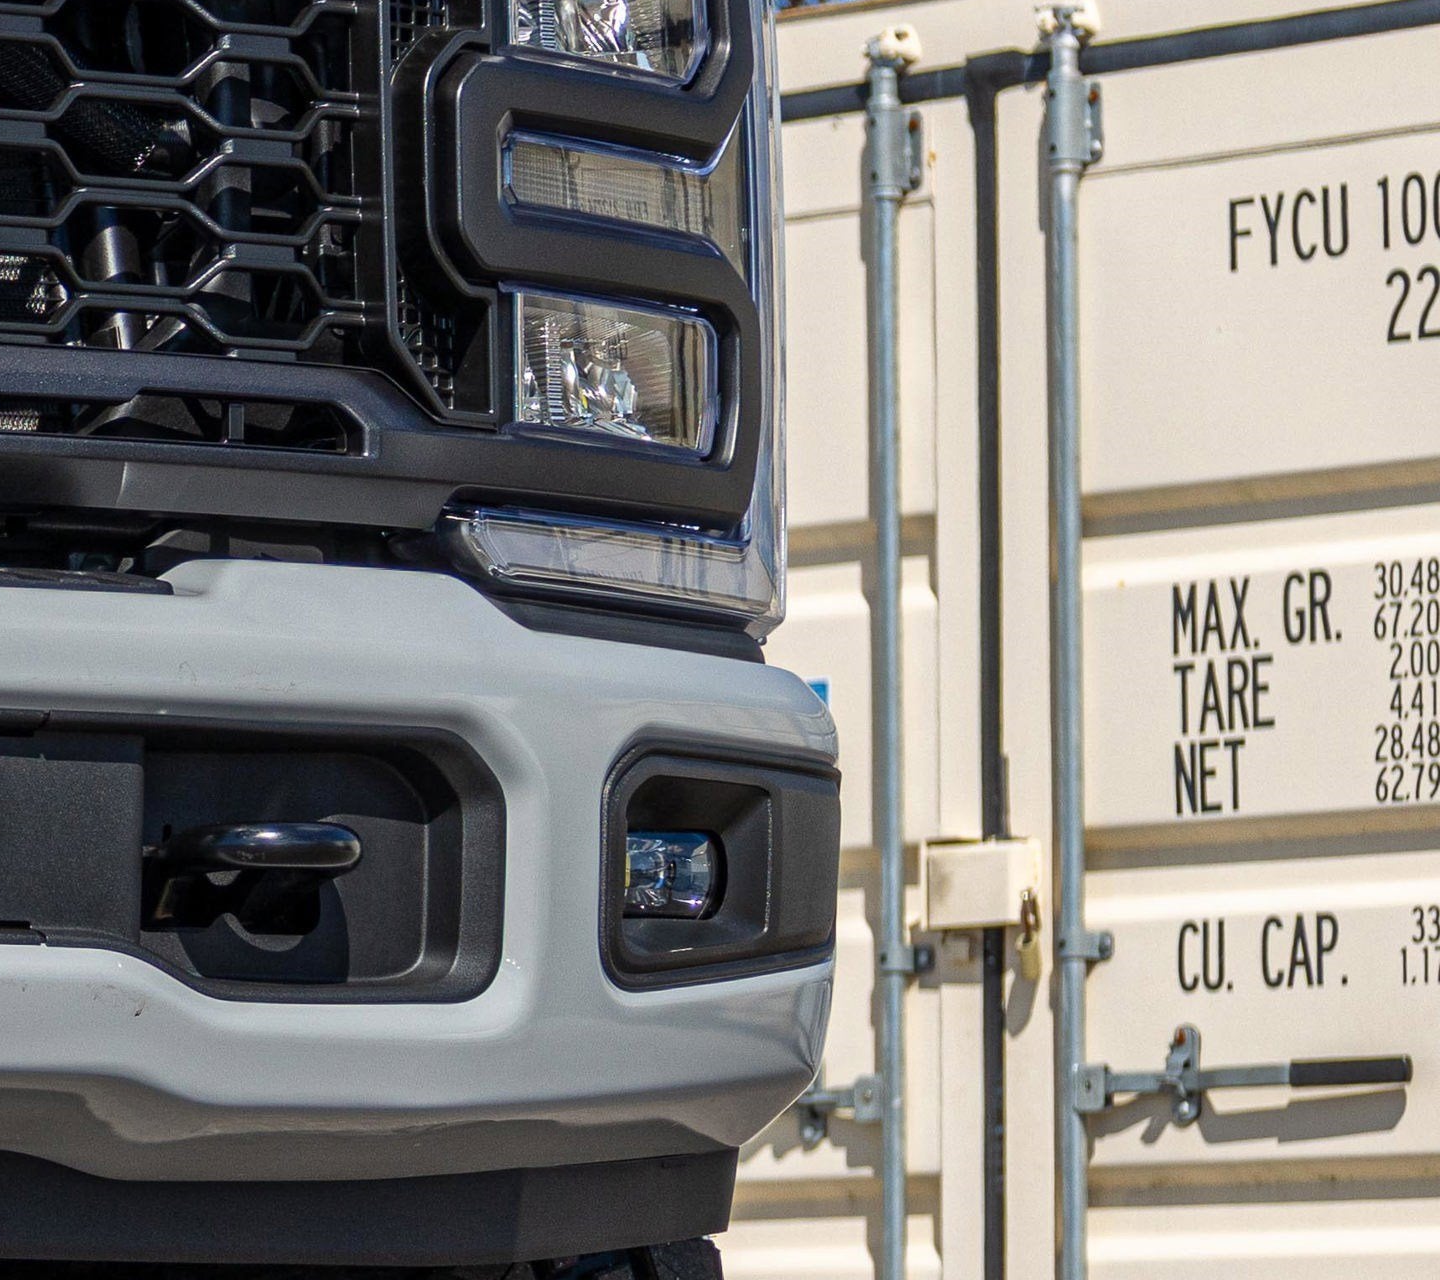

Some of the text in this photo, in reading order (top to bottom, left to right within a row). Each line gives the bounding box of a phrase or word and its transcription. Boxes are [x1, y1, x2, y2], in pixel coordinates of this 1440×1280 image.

[1229, 182, 1349, 273] FYCU
[1385, 263, 1440, 344] 22
[1172, 575, 1261, 657] MAX.
[1282, 568, 1342, 645] GR.
[1173, 653, 1276, 736] TARE
[1174, 738, 1246, 816] NET
[1177, 905, 1440, 994] CU. CAP. 33
